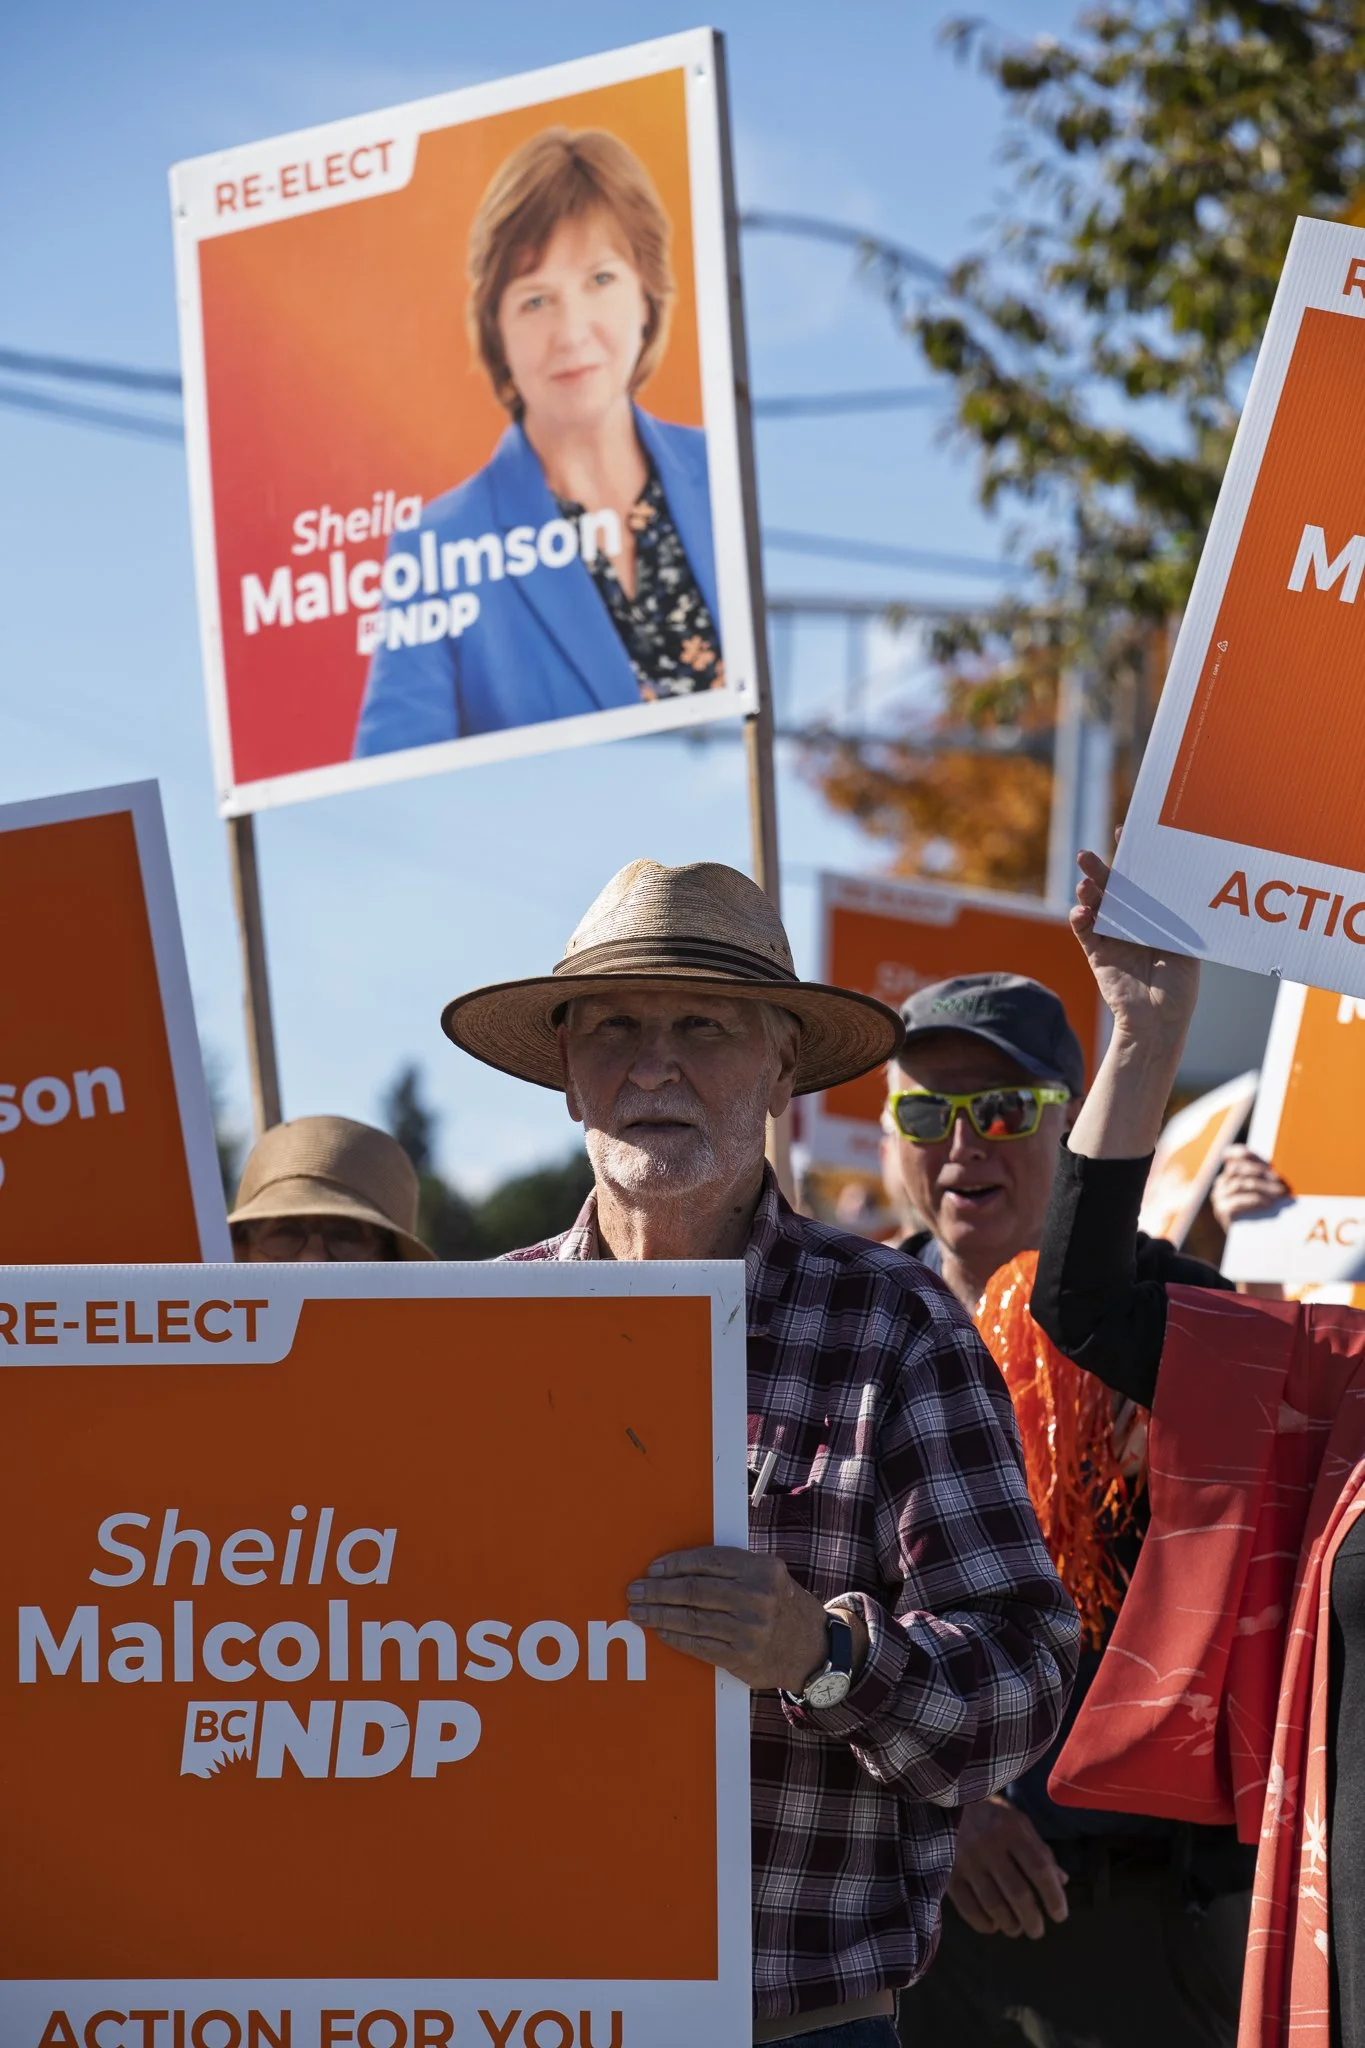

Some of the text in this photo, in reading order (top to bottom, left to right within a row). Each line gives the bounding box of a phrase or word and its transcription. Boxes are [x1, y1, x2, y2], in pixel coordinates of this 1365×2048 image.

[214, 140, 396, 216] RE-ELECT
[291, 490, 423, 555] Sheila
[240, 507, 621, 636] Malcolmson
[386, 592, 480, 652] NDP
[89, 1505, 397, 1587] Sheila
[18, 1600, 647, 1684] Malcolmson
[193, 1700, 482, 1778] BC NDP
[37, 2009, 623, 2048] ACTION FOR YOU
